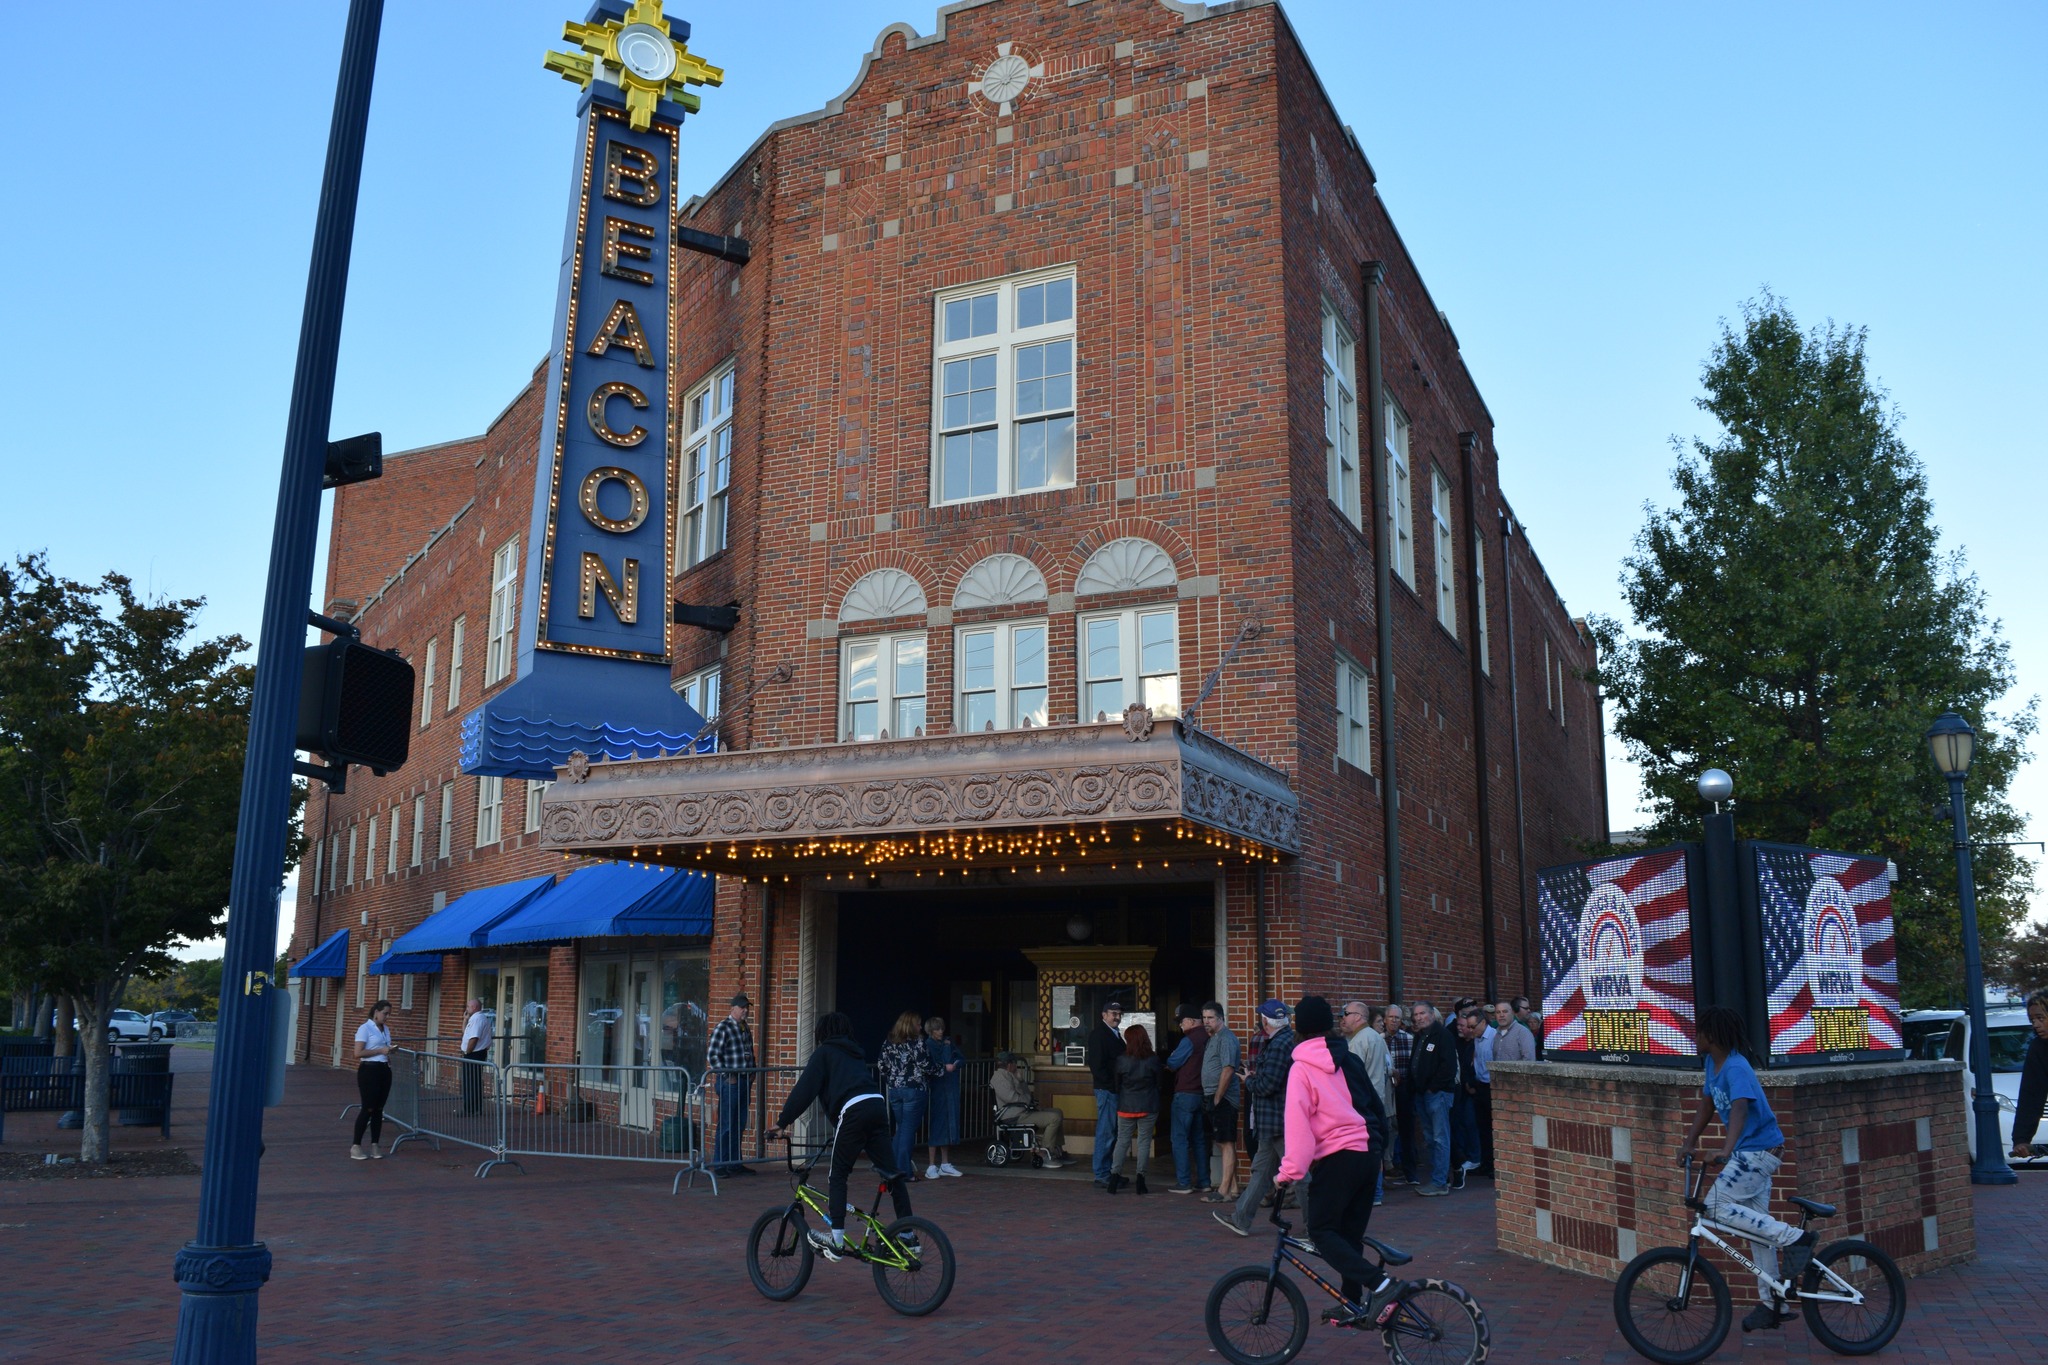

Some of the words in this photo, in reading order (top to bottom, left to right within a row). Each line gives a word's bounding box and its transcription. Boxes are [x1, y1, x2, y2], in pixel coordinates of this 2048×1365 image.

[577, 139, 661, 624] BEACON
[1590, 974, 1633, 997] WRVA
[1817, 970, 1855, 994] WRVA
[1583, 1010, 1650, 1052] TONIGHT
[1811, 1008, 1869, 1051] TONIGHT
[1716, 1239, 1762, 1276] LEGION
